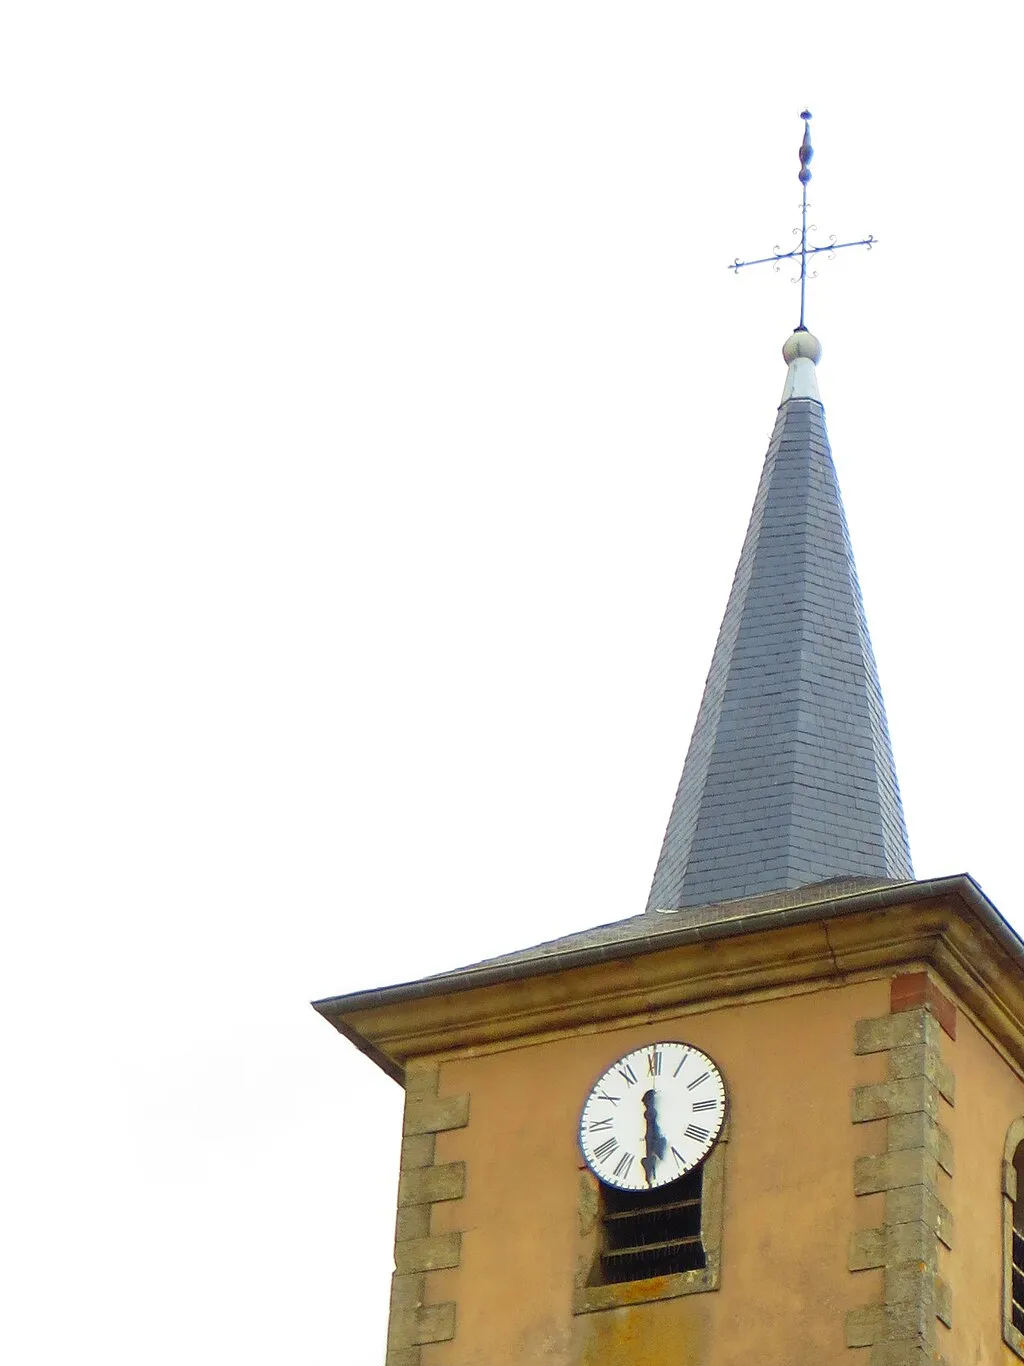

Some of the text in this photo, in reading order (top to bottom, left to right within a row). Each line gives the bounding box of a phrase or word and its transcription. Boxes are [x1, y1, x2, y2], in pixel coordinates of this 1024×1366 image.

[648, 1052, 662, 1076] XII
[619, 1065, 638, 1088] XI
[687, 1072, 710, 1091] II
[598, 1090, 621, 1106] X
[692, 1099, 717, 1112] III
[589, 1117, 613, 1132] IX
[684, 1124, 710, 1143] IIII
[594, 1137, 620, 1164] VIII
[671, 1146, 686, 1168] V
[613, 1152, 635, 1179] VII
